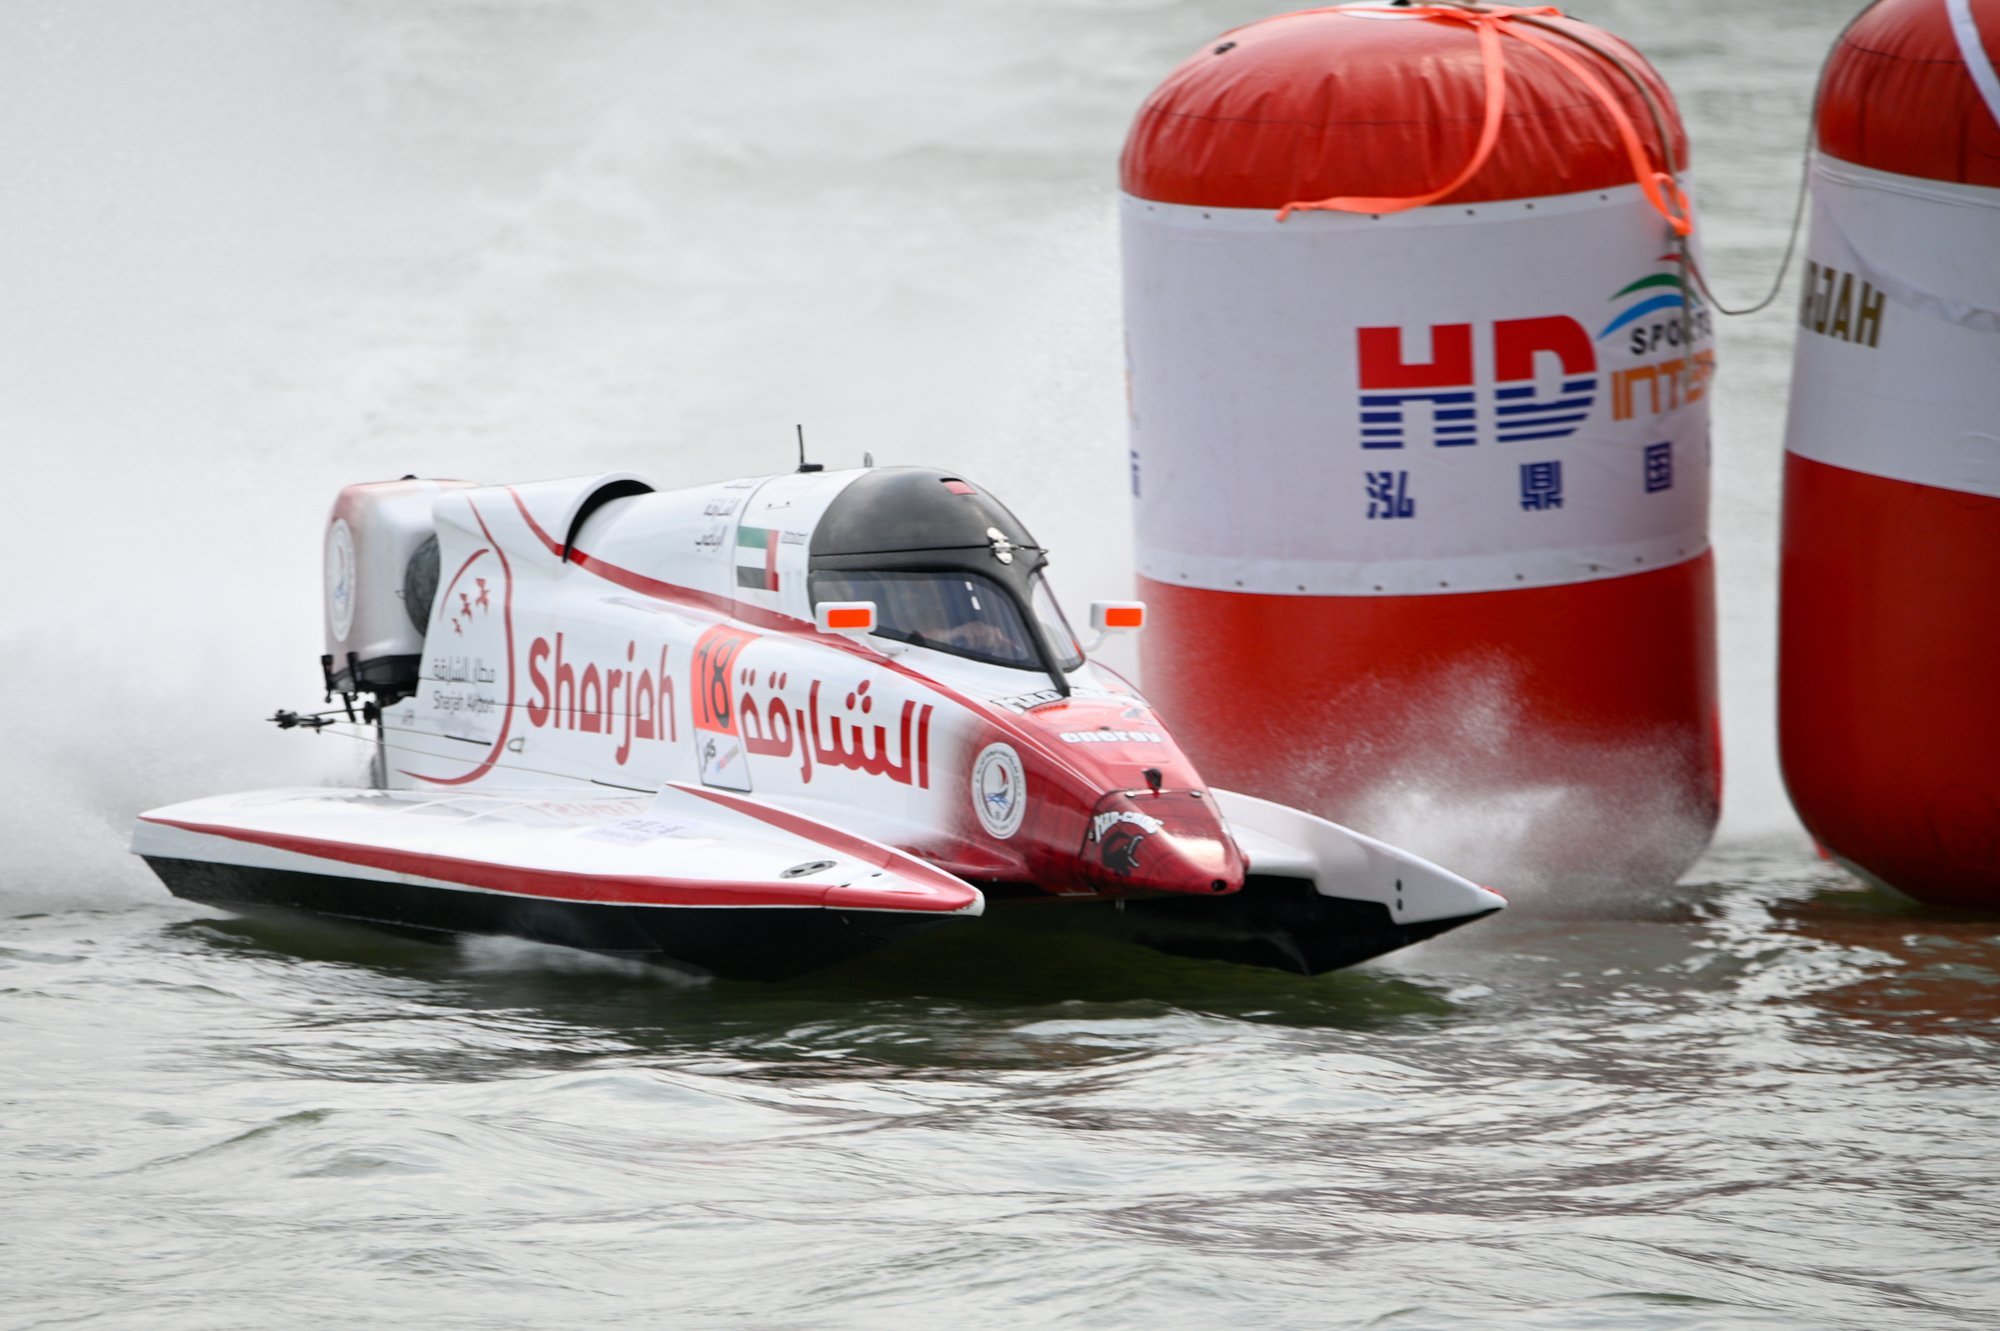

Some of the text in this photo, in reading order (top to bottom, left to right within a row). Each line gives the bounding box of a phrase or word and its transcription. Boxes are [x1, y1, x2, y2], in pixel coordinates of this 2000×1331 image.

[1357, 315, 1597, 449] HD
[527, 632, 677, 766] Sharjah
[698, 634, 741, 729] 18
[739, 668, 935, 790] الشارقة
